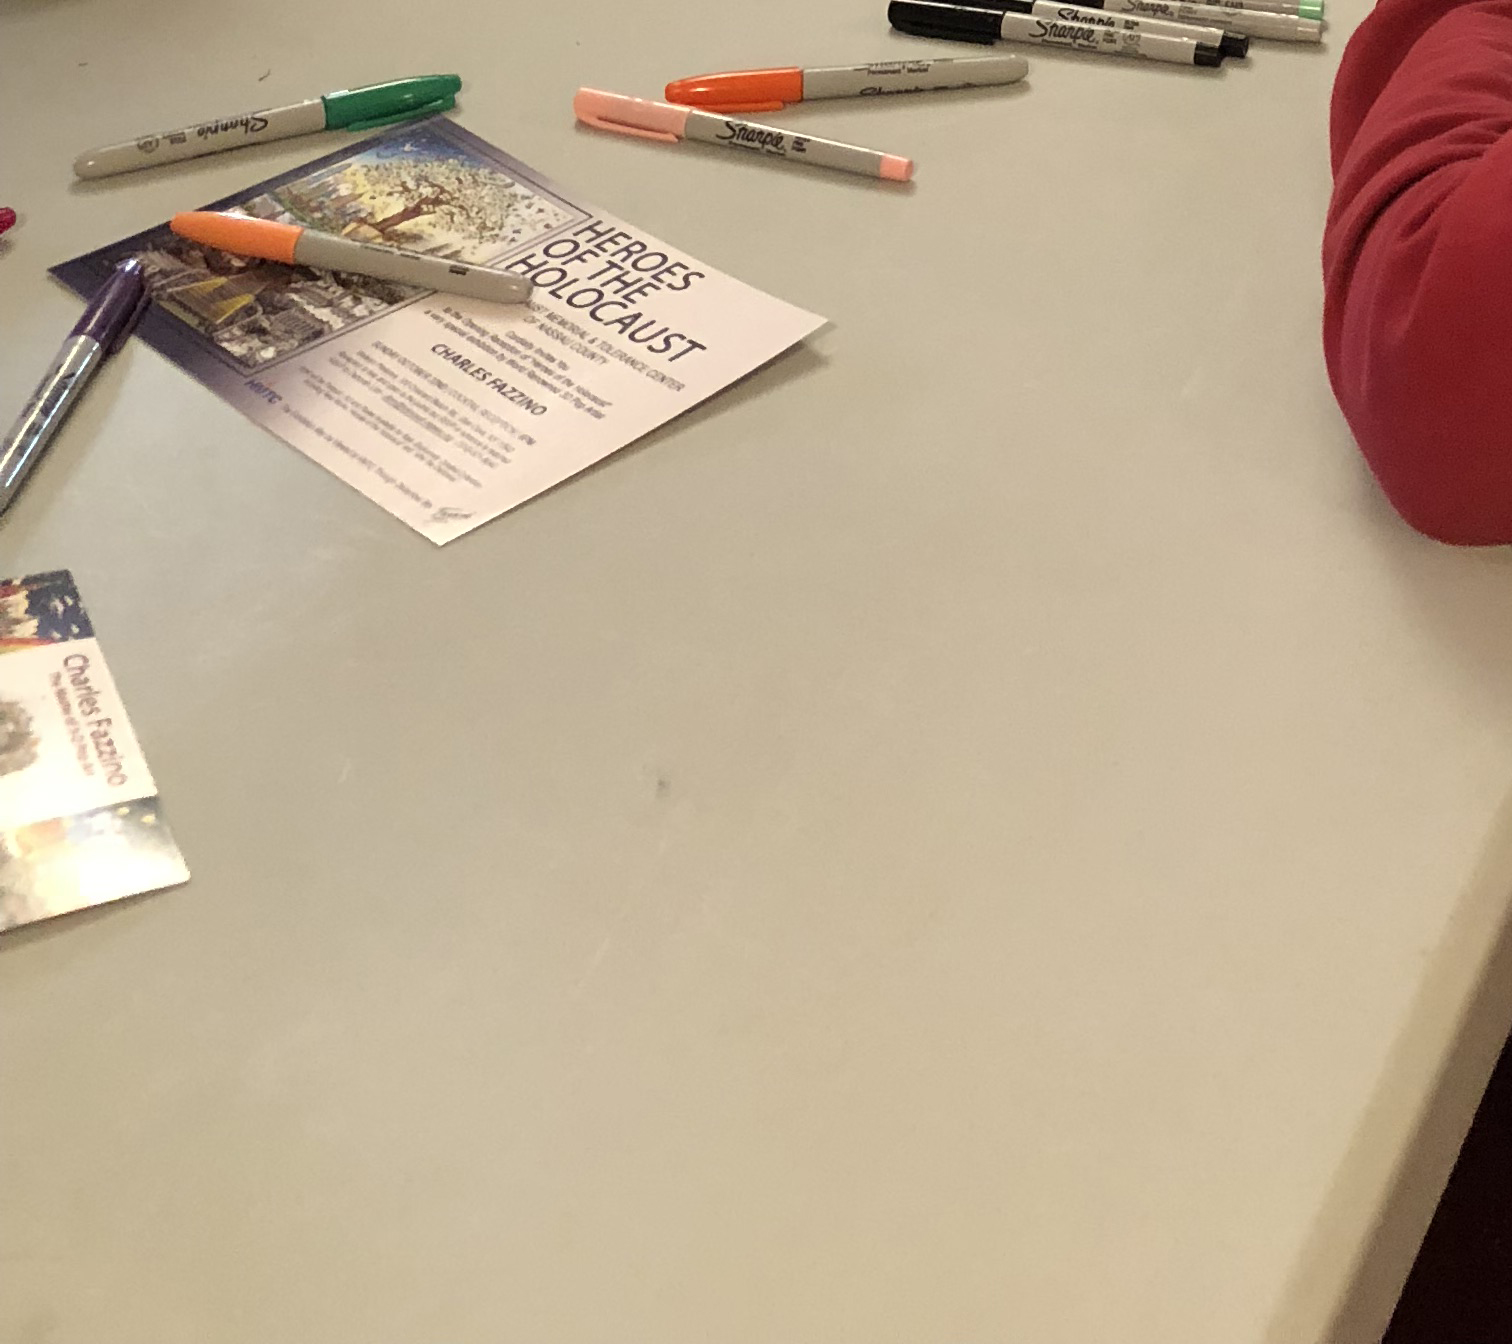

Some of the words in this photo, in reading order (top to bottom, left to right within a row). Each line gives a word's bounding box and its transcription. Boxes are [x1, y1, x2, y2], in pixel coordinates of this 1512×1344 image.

[1028, 19, 1097, 45] Sharpie
[716, 120, 785, 150] Sharpie
[542, 237, 600, 266] OF
[586, 259, 662, 305] THE
[572, 219, 706, 292] HEROES
[505, 252, 708, 363] HOLOCAUST
[431, 343, 493, 381] CHARLES
[486, 377, 548, 417] FAZZINO
[566, 341, 612, 366] COUNTY
[592, 340, 652, 372] TOLERANCE
[643, 368, 688, 392] CENTER
[62, 651, 104, 720] Charles
[86, 714, 129, 787] Fazzino
